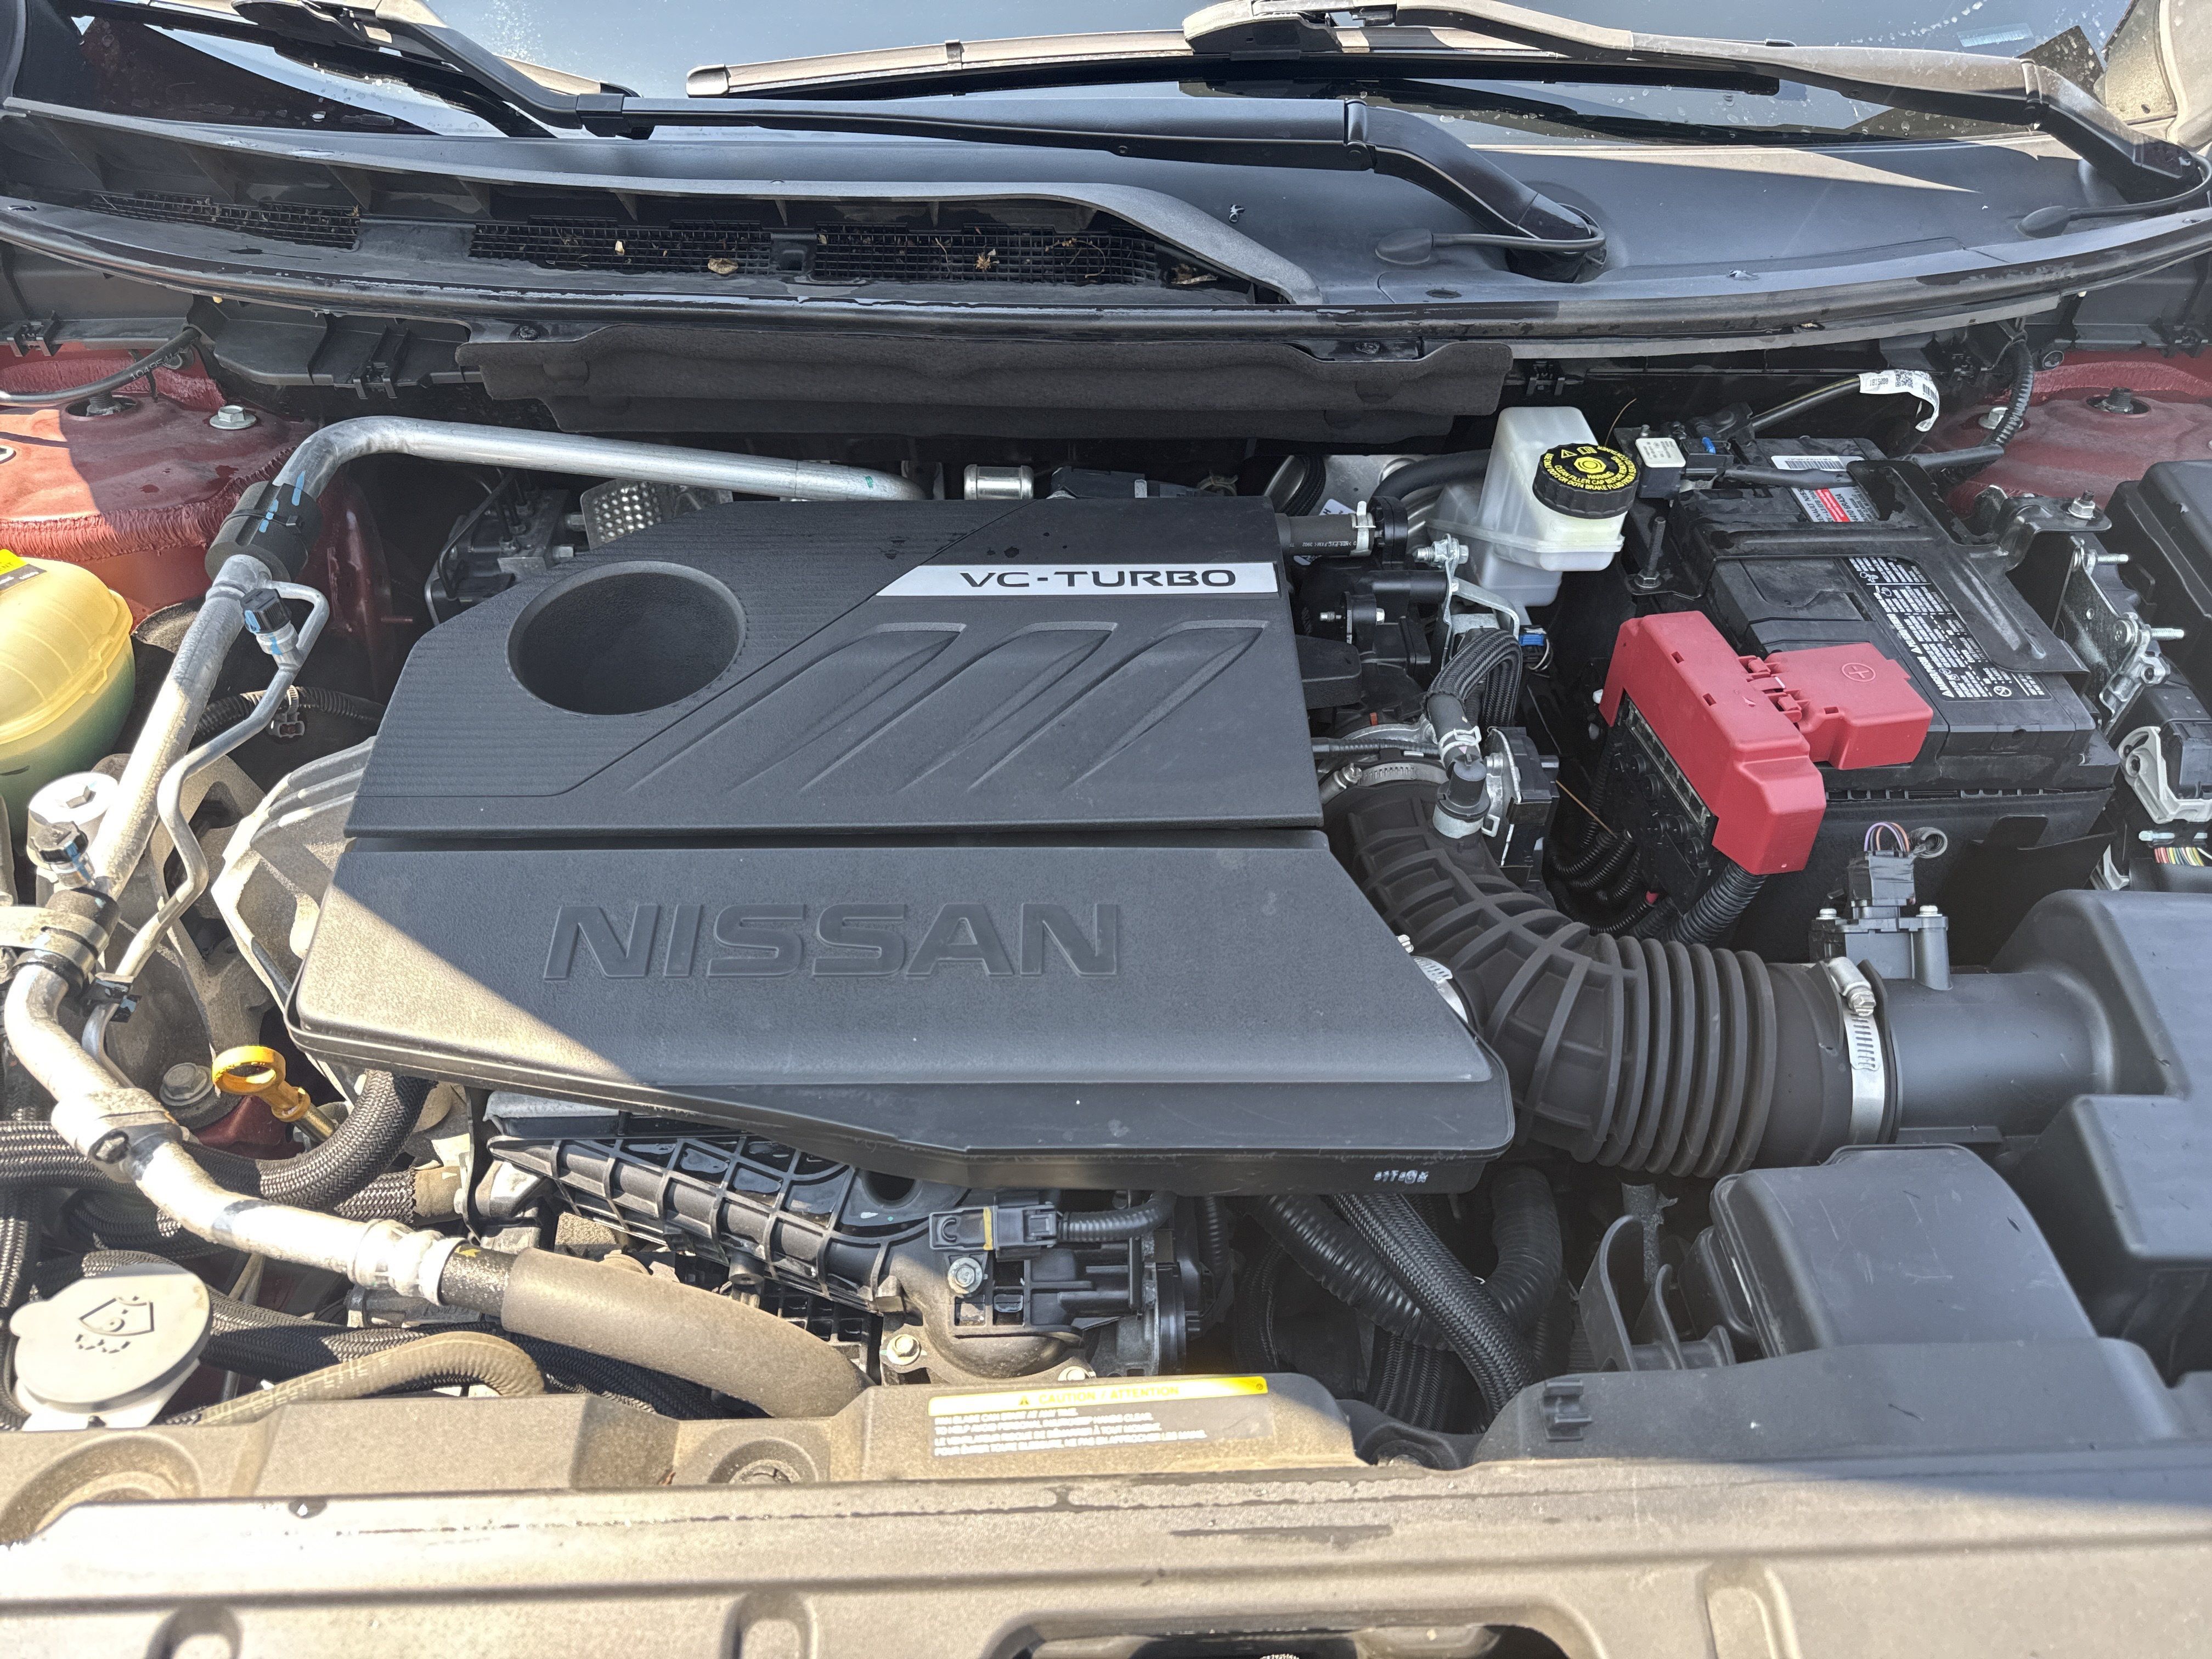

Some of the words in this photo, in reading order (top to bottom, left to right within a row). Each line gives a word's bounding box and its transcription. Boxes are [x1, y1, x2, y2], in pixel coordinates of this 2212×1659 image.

[1547, 469, 1561, 478] DOT3
[1607, 482, 1624, 490] FLUID
[1555, 465, 1571, 477] CLEAN
[1568, 475, 1591, 484] FILLER
[1605, 473, 1626, 484] BEFORE
[1587, 471, 1615, 480] WARNING
[960, 569, 1237, 589] VC-TURBO
[543, 902, 1119, 981] NISSAN
[1039, 1391, 1096, 1404] CAUTION
[1110, 1386, 1180, 1399] ATTENTION
